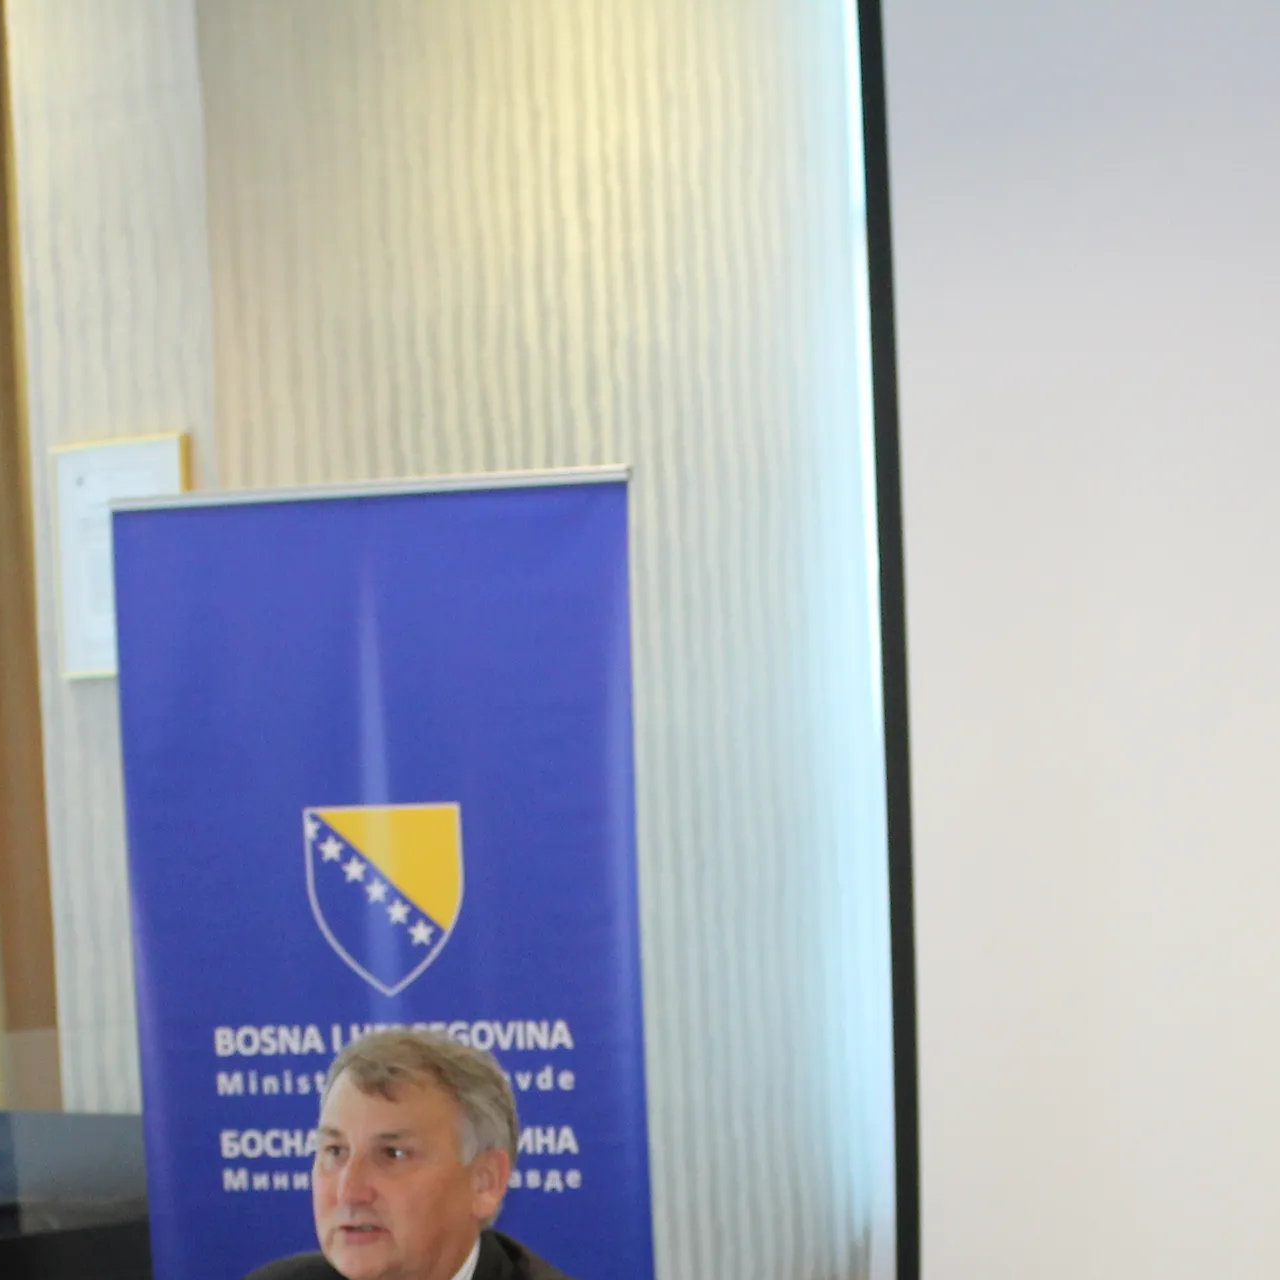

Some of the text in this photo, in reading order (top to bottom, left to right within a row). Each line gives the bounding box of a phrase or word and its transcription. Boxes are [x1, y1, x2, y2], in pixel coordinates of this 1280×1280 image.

[214, 1023, 325, 1057] BOSNA
[350, 1019, 574, 1051] GOVINA
[220, 1128, 318, 1159] БОСНА
[508, 1168, 582, 1193] авде
